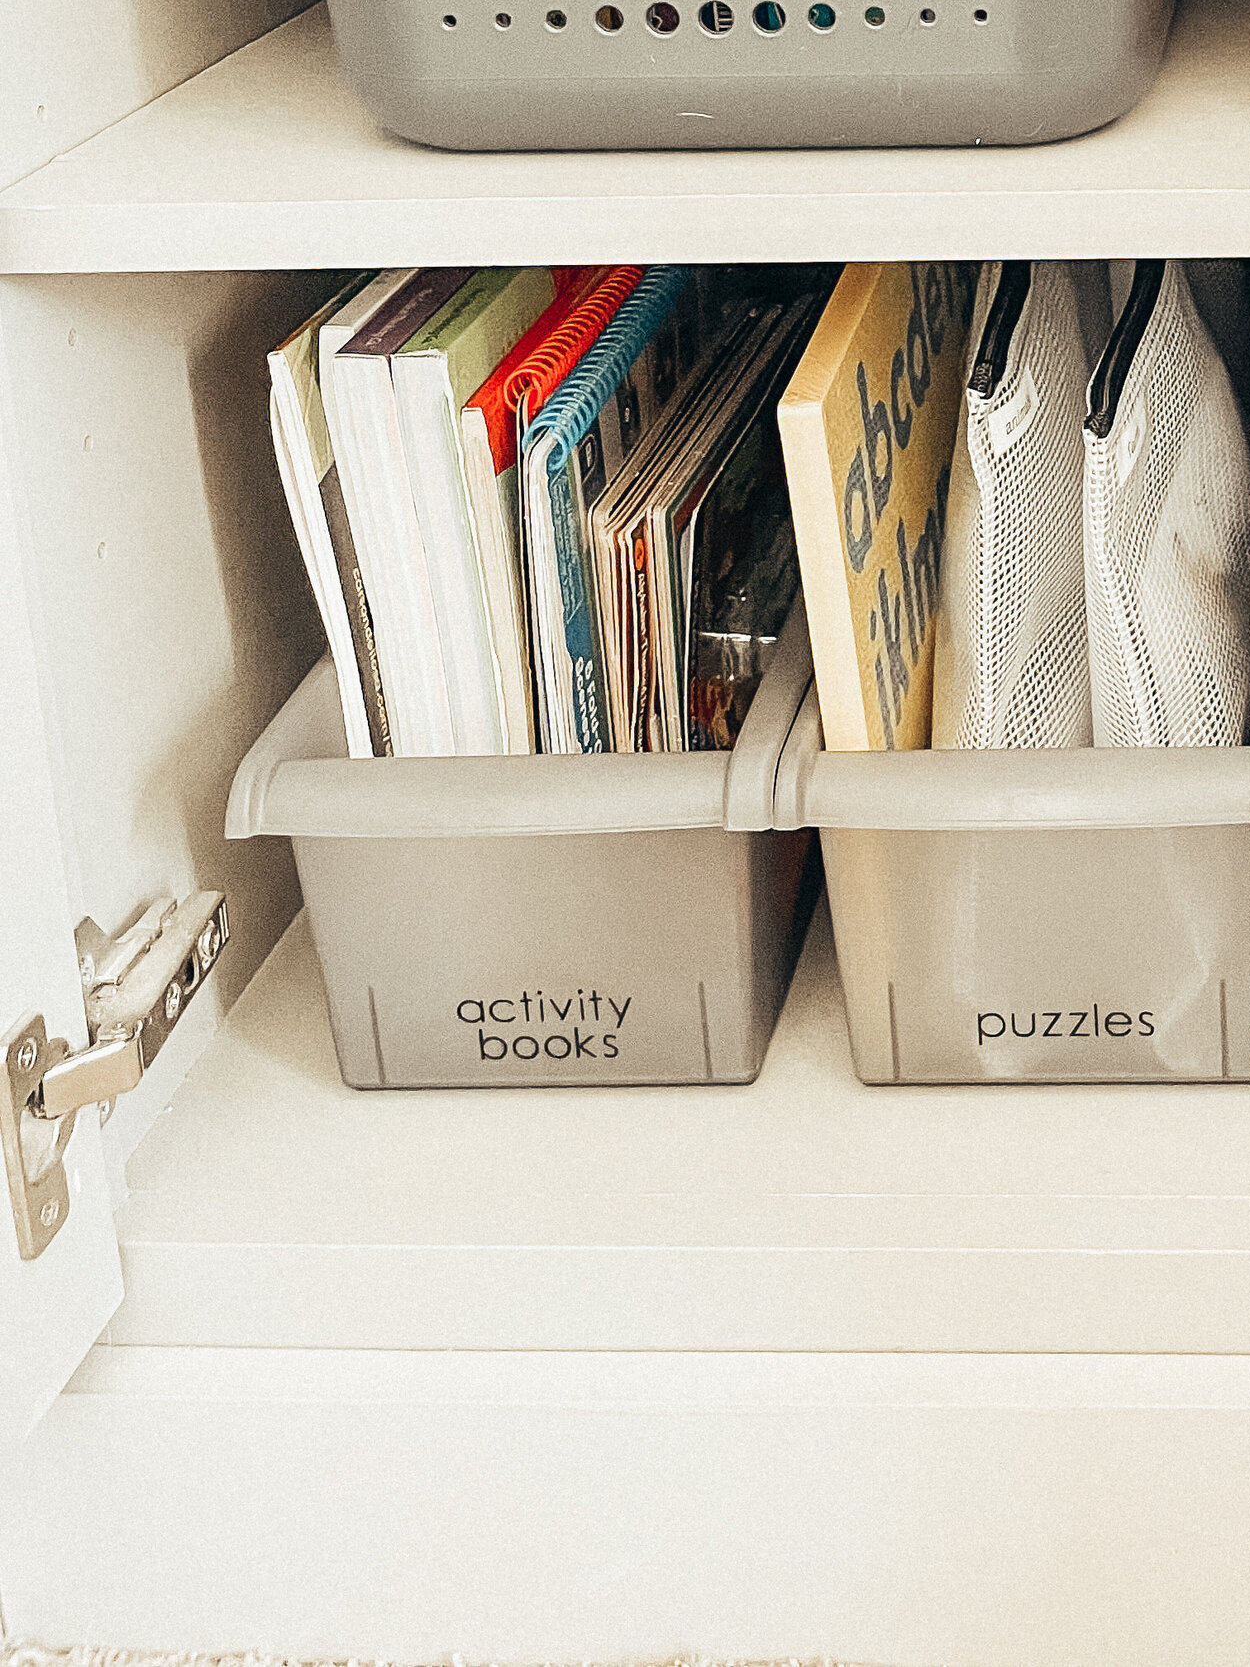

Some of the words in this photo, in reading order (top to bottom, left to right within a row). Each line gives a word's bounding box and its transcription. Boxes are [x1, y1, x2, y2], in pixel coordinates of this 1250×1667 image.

[455, 988, 633, 1026] activity
[976, 1003, 1156, 1047] puzzles
[478, 1025, 621, 1061] books
